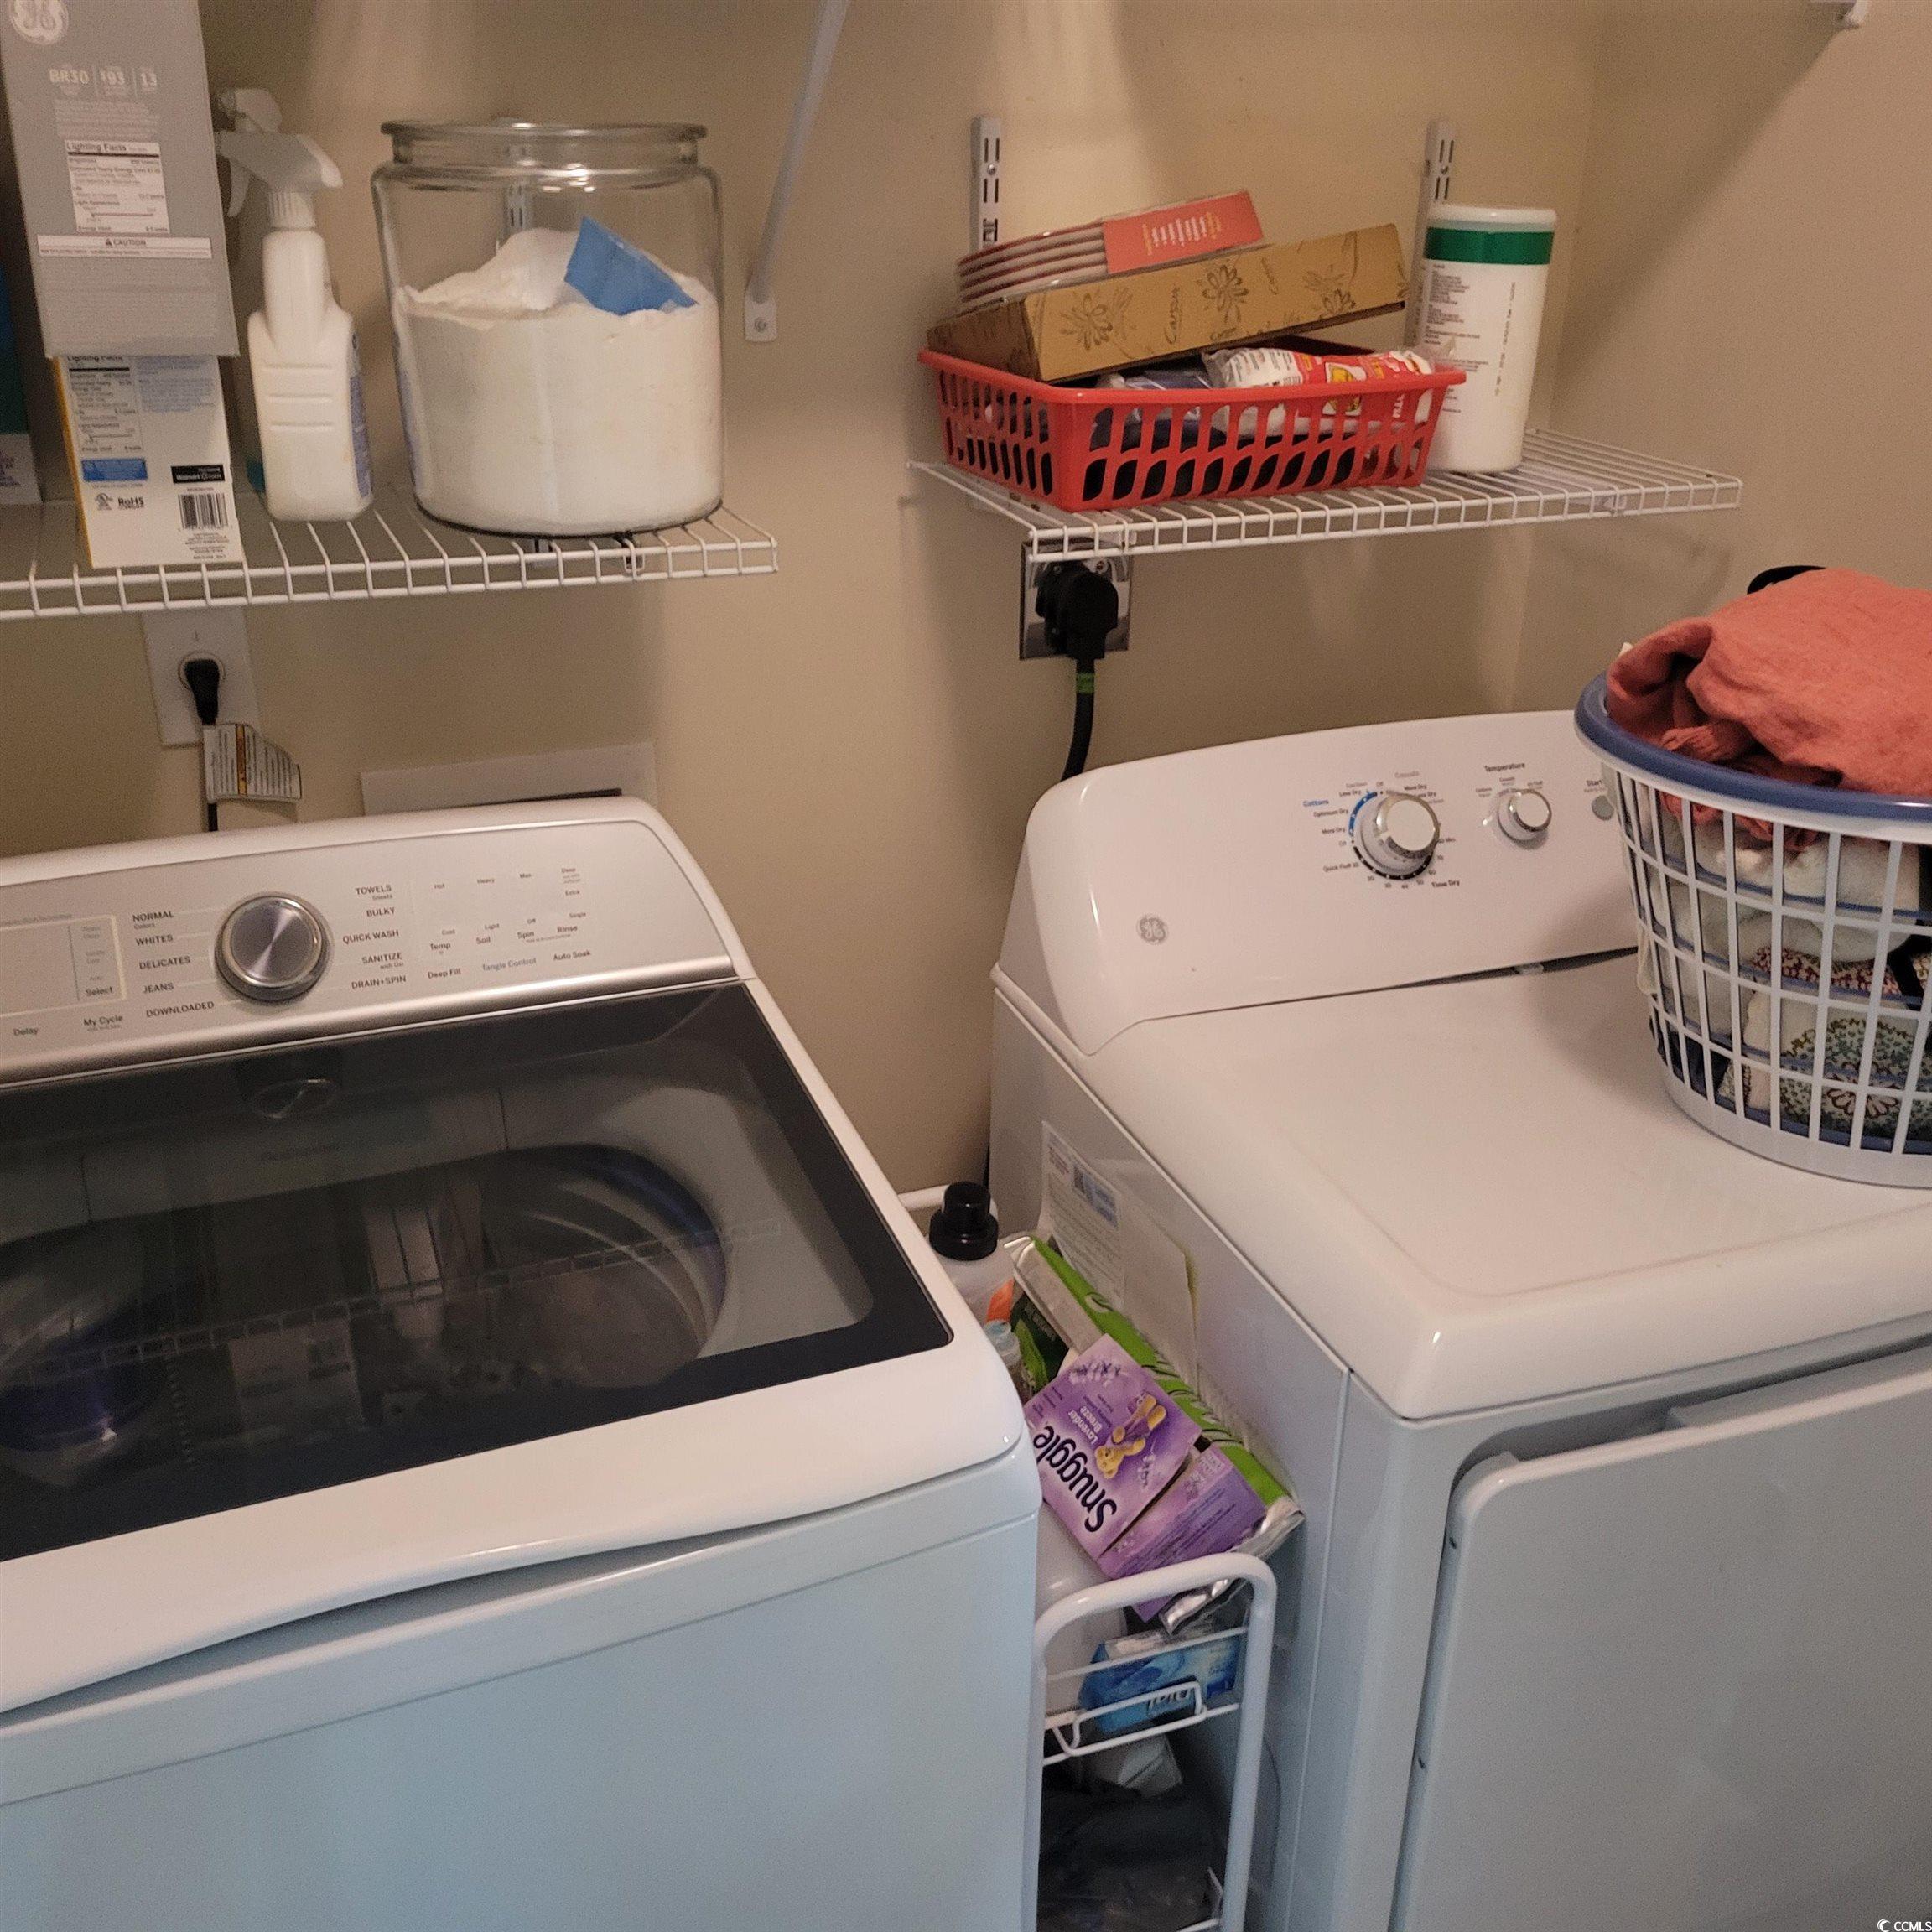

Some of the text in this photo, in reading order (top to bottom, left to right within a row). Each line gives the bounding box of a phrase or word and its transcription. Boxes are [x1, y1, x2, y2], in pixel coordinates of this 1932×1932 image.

[1484, 762, 1525, 772] Temperature
[355, 884, 392, 896] TOWELS
[132, 911, 174, 922] NORMAL
[366, 906, 395, 917] BULKY
[556, 925, 579, 933] Rinse
[136, 933, 174, 946] WHITES
[342, 929, 399, 945] QUICK WASH
[475, 936, 491, 945] Soil
[517, 931, 534, 940] Spin
[429, 942, 451, 951] Temp
[361, 951, 402, 964] SANITIZE
[553, 948, 591, 962] Auto Soak
[138, 955, 191, 970] DELICATES
[482, 957, 537, 972] Tangle Control
[428, 967, 461, 979] Deep Fill
[85, 986, 113, 998] Select
[143, 982, 174, 994] JEANS
[145, 1000, 215, 1018] DOWNLOADED
[83, 1014, 123, 1026] My Cycle
[13, 1026, 39, 1036] Delay
[1079, 1406, 1102, 1433] Breeze
[1067, 1409, 1098, 1445] Lavender
[1032, 1425, 1118, 1533] Snuggle
